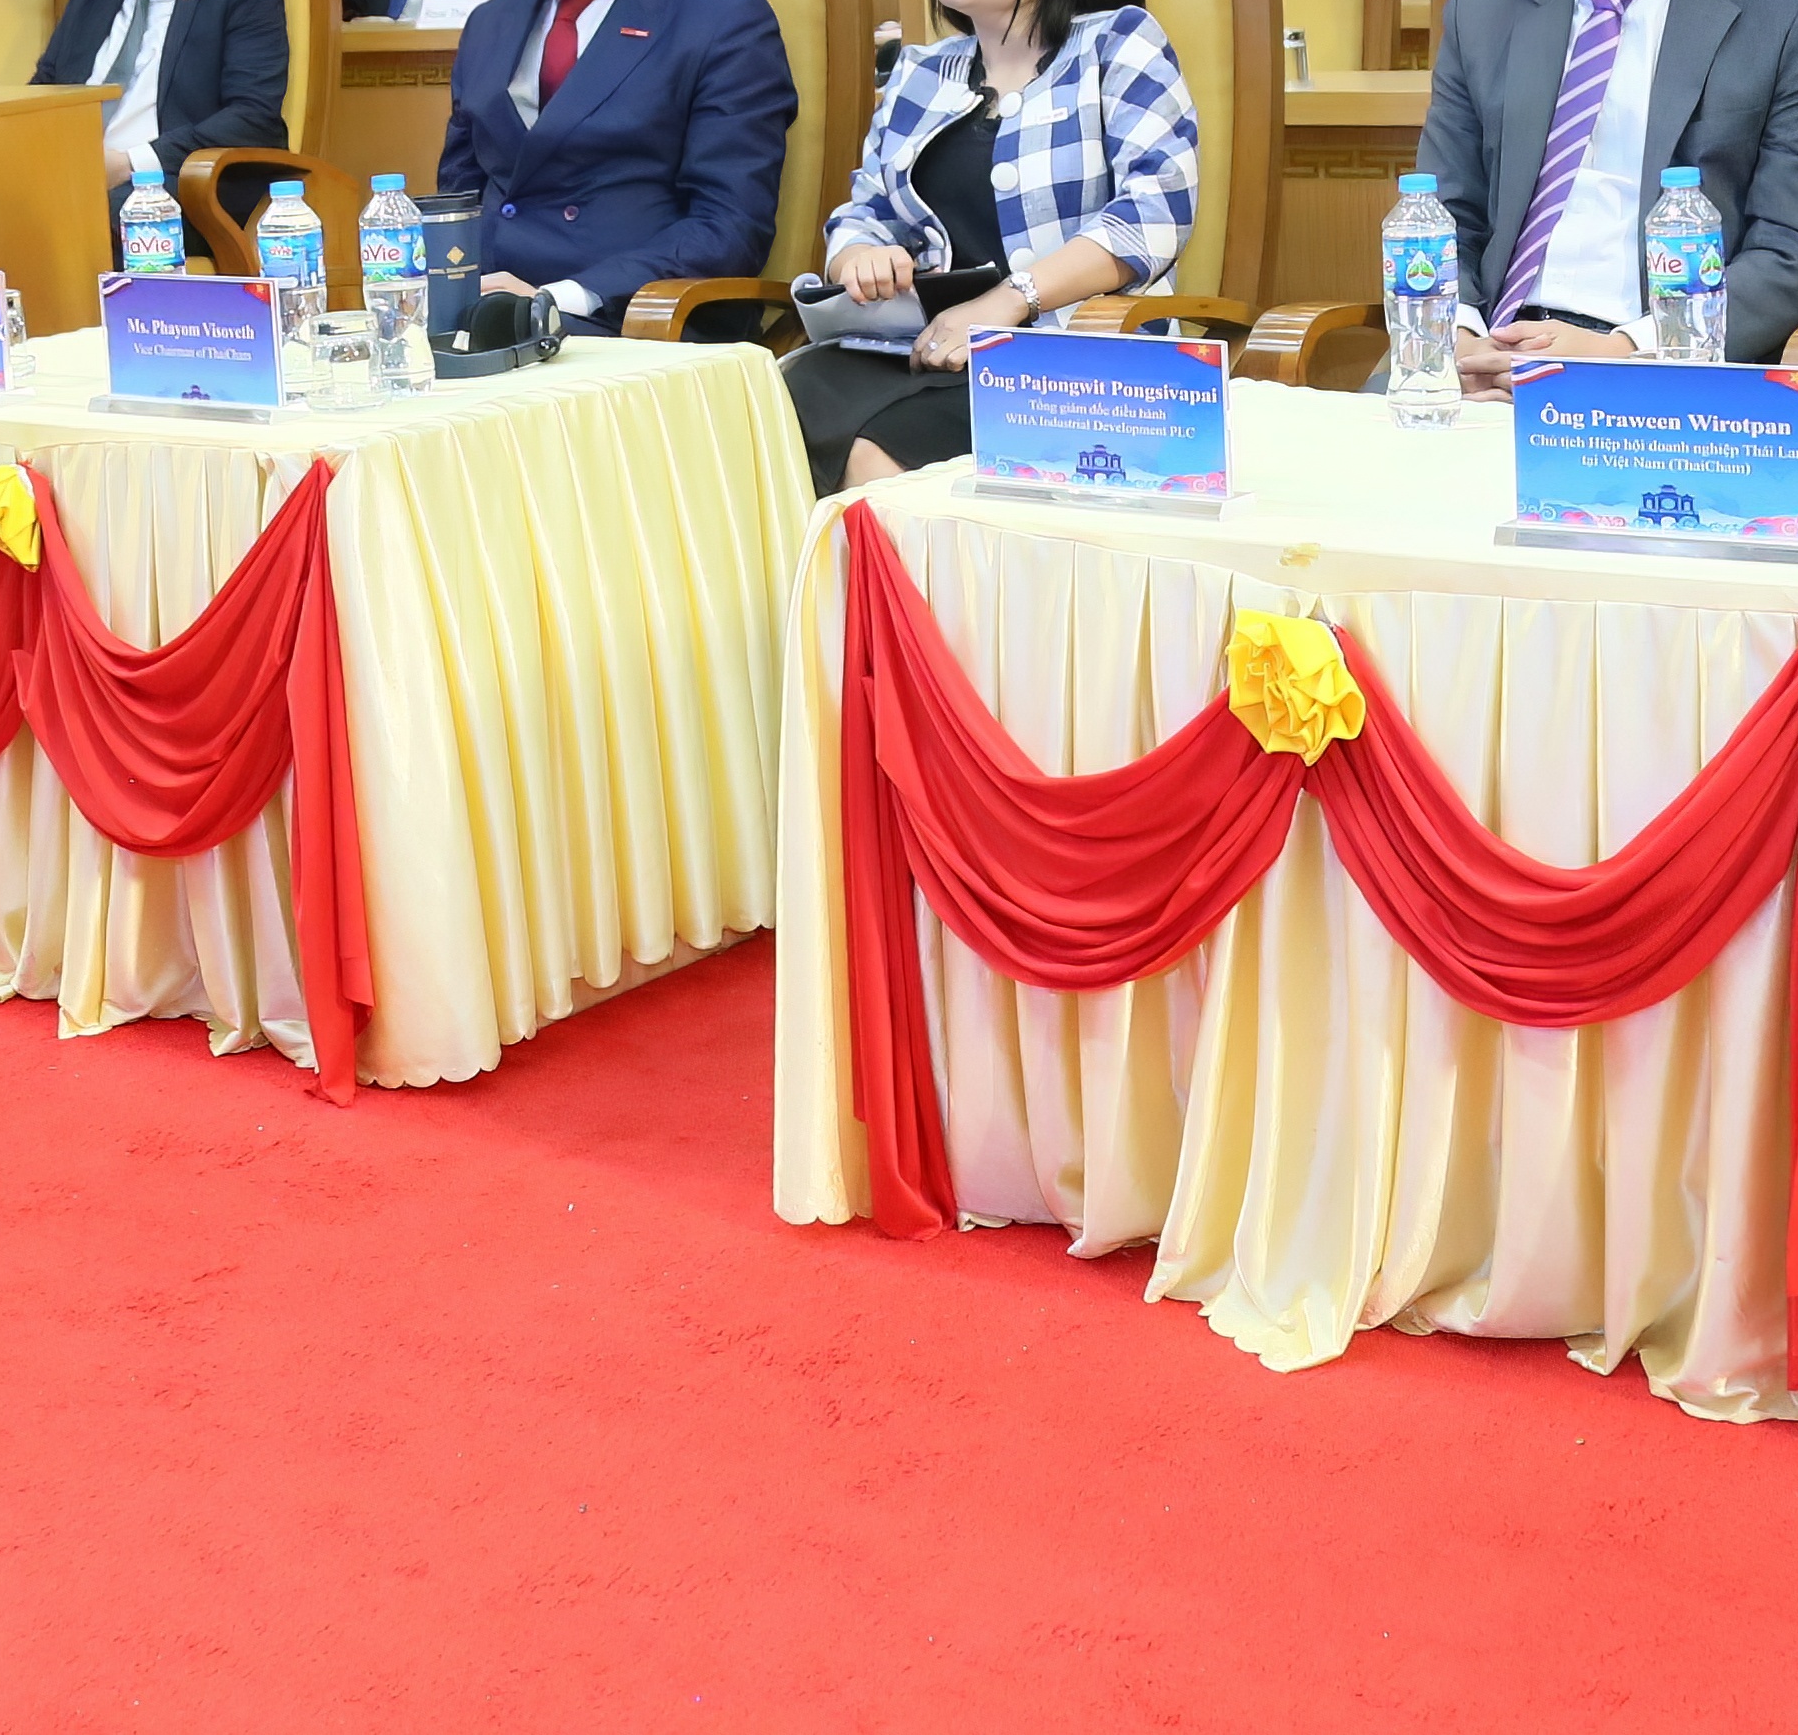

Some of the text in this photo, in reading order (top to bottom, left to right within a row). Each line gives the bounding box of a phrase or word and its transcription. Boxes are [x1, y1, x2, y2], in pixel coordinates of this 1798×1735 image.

[127, 318, 149, 335] Ms.
[151, 319, 201, 339] Phayom
[978, 366, 1218, 405] Ông Pajongwit Pongsivapai
[1005, 412, 1038, 427] WHA
[1094, 419, 1168, 437] Development
[1169, 425, 1196, 439] PLC
[1539, 402, 1791, 438] Ông Praween Wirotpan
[1633, 457, 1666, 471] Nam
